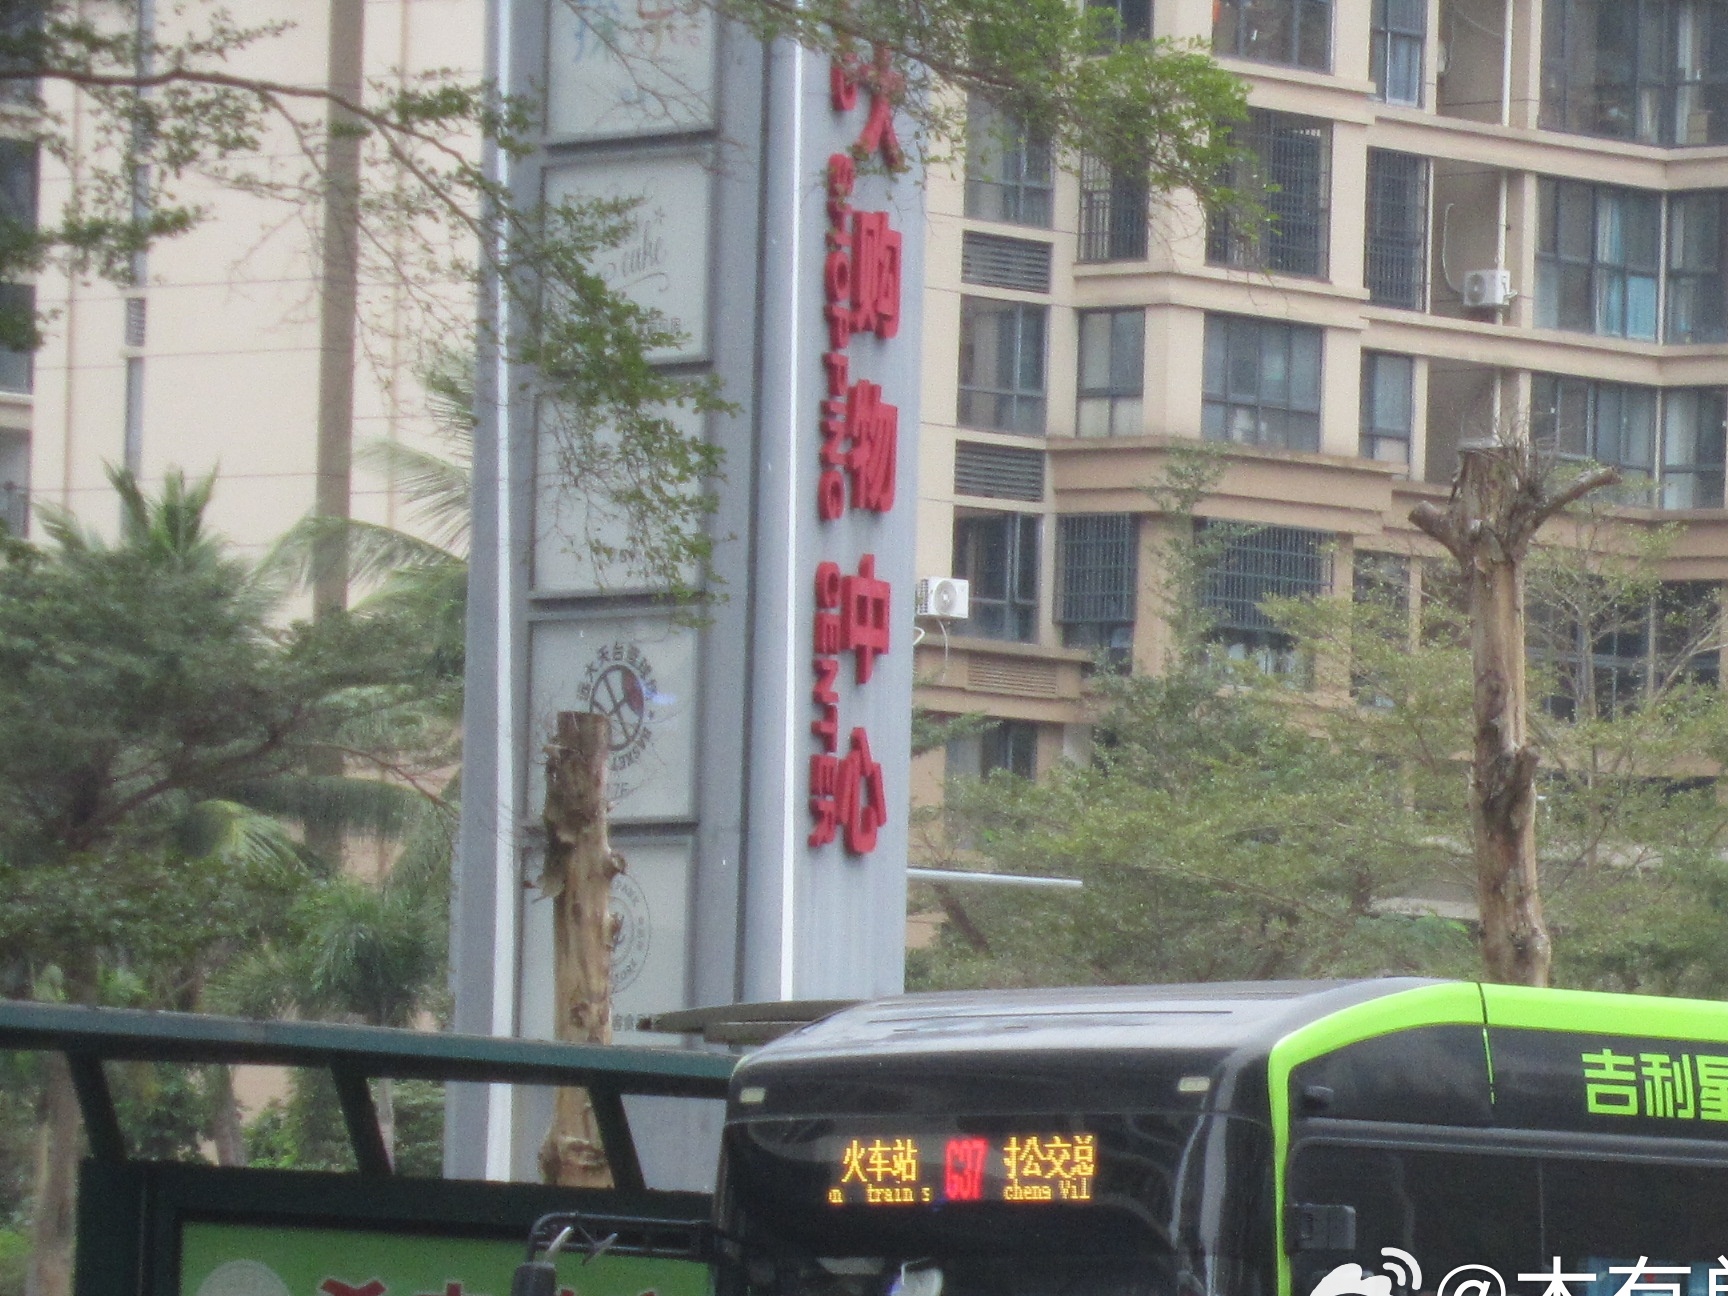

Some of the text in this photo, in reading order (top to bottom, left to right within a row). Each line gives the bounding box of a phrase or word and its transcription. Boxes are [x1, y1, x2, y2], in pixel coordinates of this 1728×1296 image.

[808, 154, 854, 848] SHOPPING CENTER
[842, 1139, 918, 1182] 火车站
